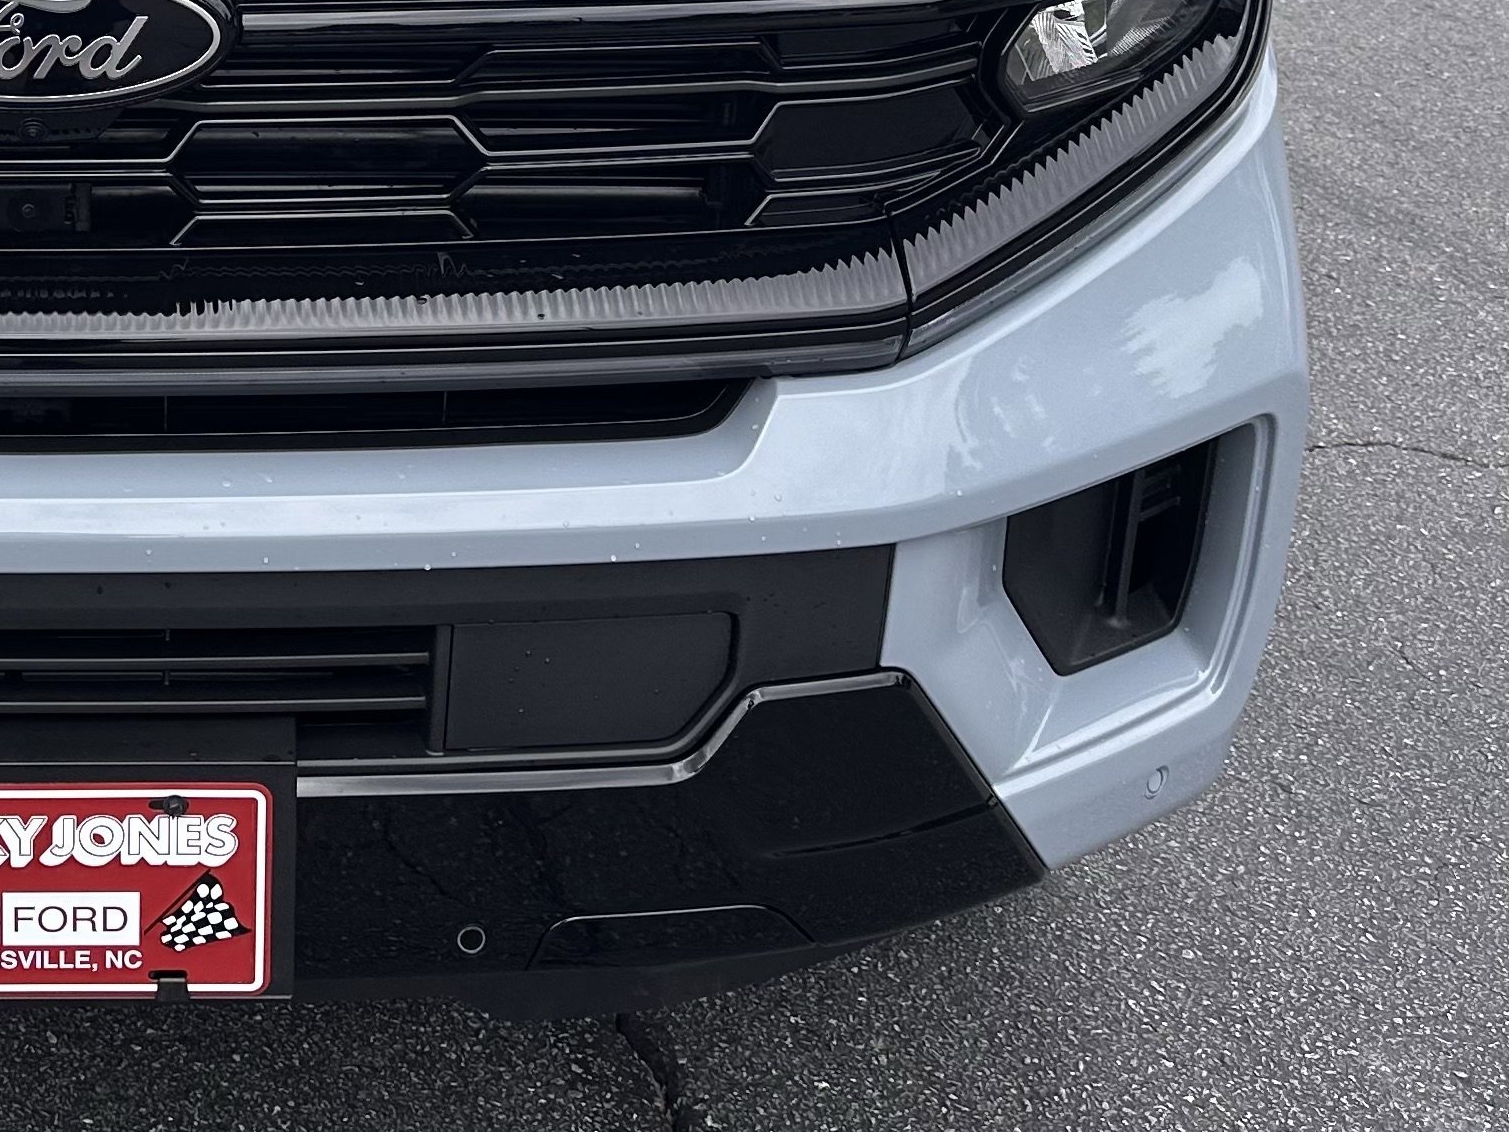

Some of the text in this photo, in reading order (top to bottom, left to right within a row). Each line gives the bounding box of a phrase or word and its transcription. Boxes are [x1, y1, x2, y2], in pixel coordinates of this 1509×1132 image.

[39, 814, 239, 868] JONES
[13, 905, 129, 933] FORD
[105, 950, 143, 969] NC
